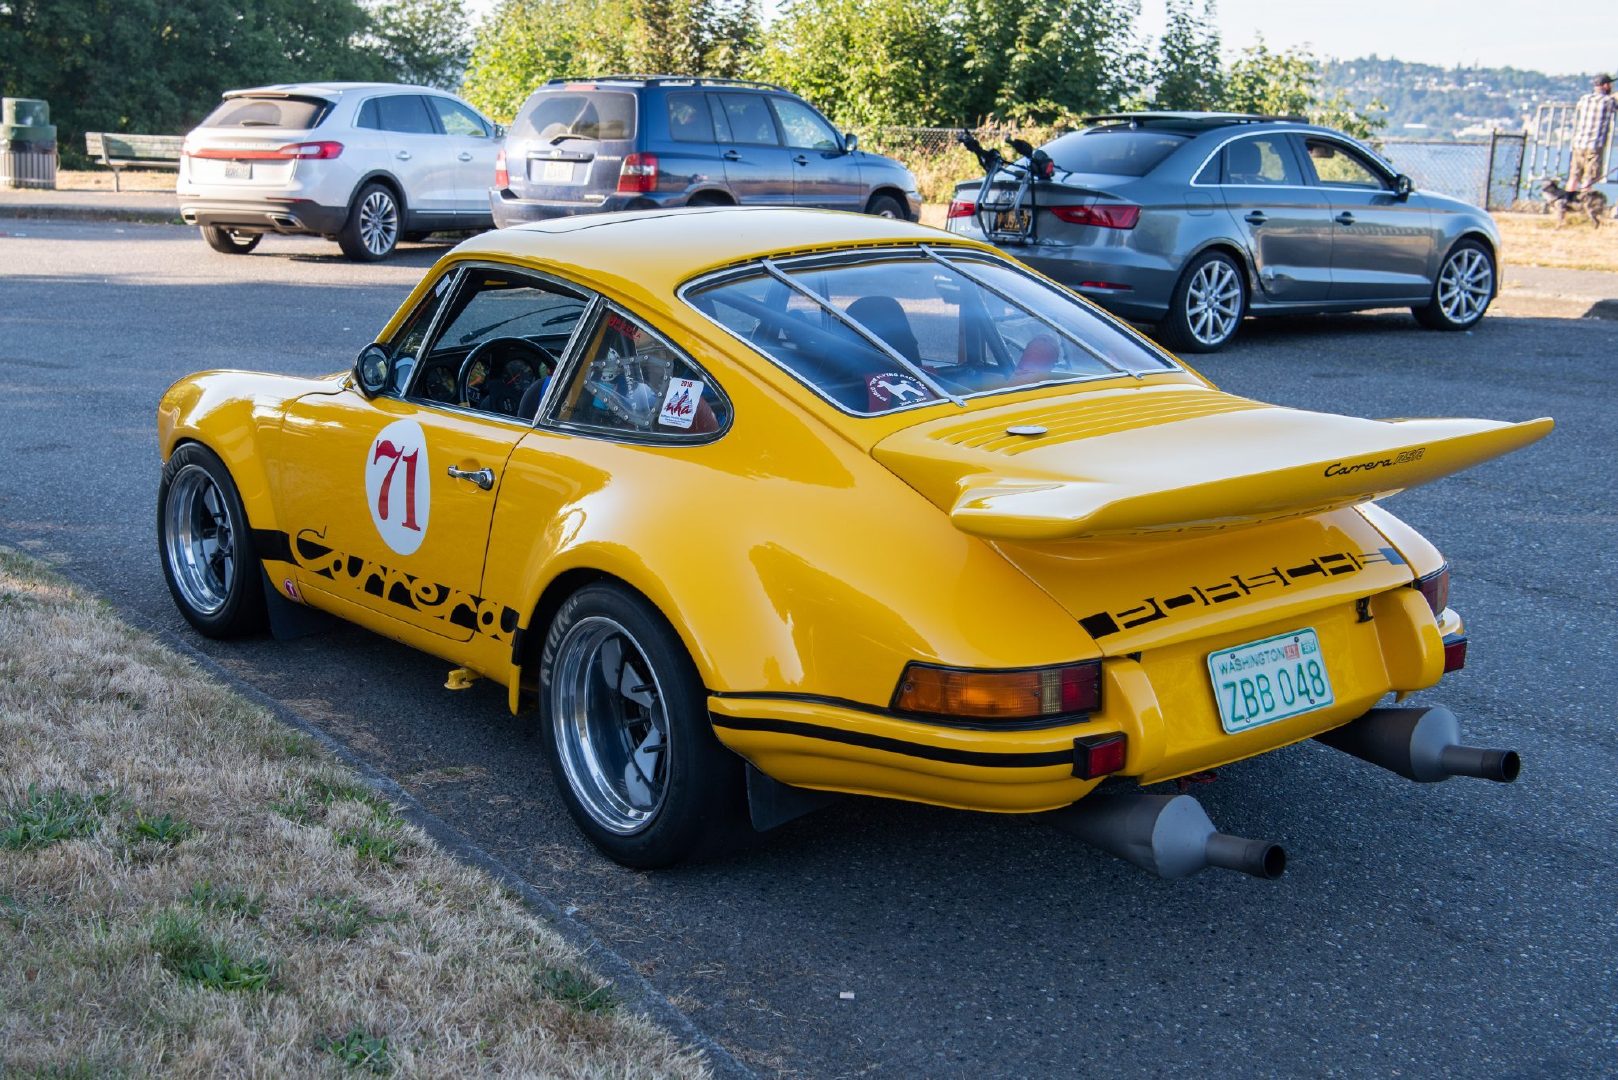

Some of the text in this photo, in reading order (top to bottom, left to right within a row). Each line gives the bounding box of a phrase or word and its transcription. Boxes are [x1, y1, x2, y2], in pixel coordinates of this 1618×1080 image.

[373, 439, 421, 532] 71
[1324, 459, 1393, 478] Carrera
[289, 525, 515, 647] Carrera
[1105, 548, 1390, 634] PORSCHE
[1219, 648, 1286, 675] WASHINGTON
[1223, 659, 1325, 722] ZBB 048
